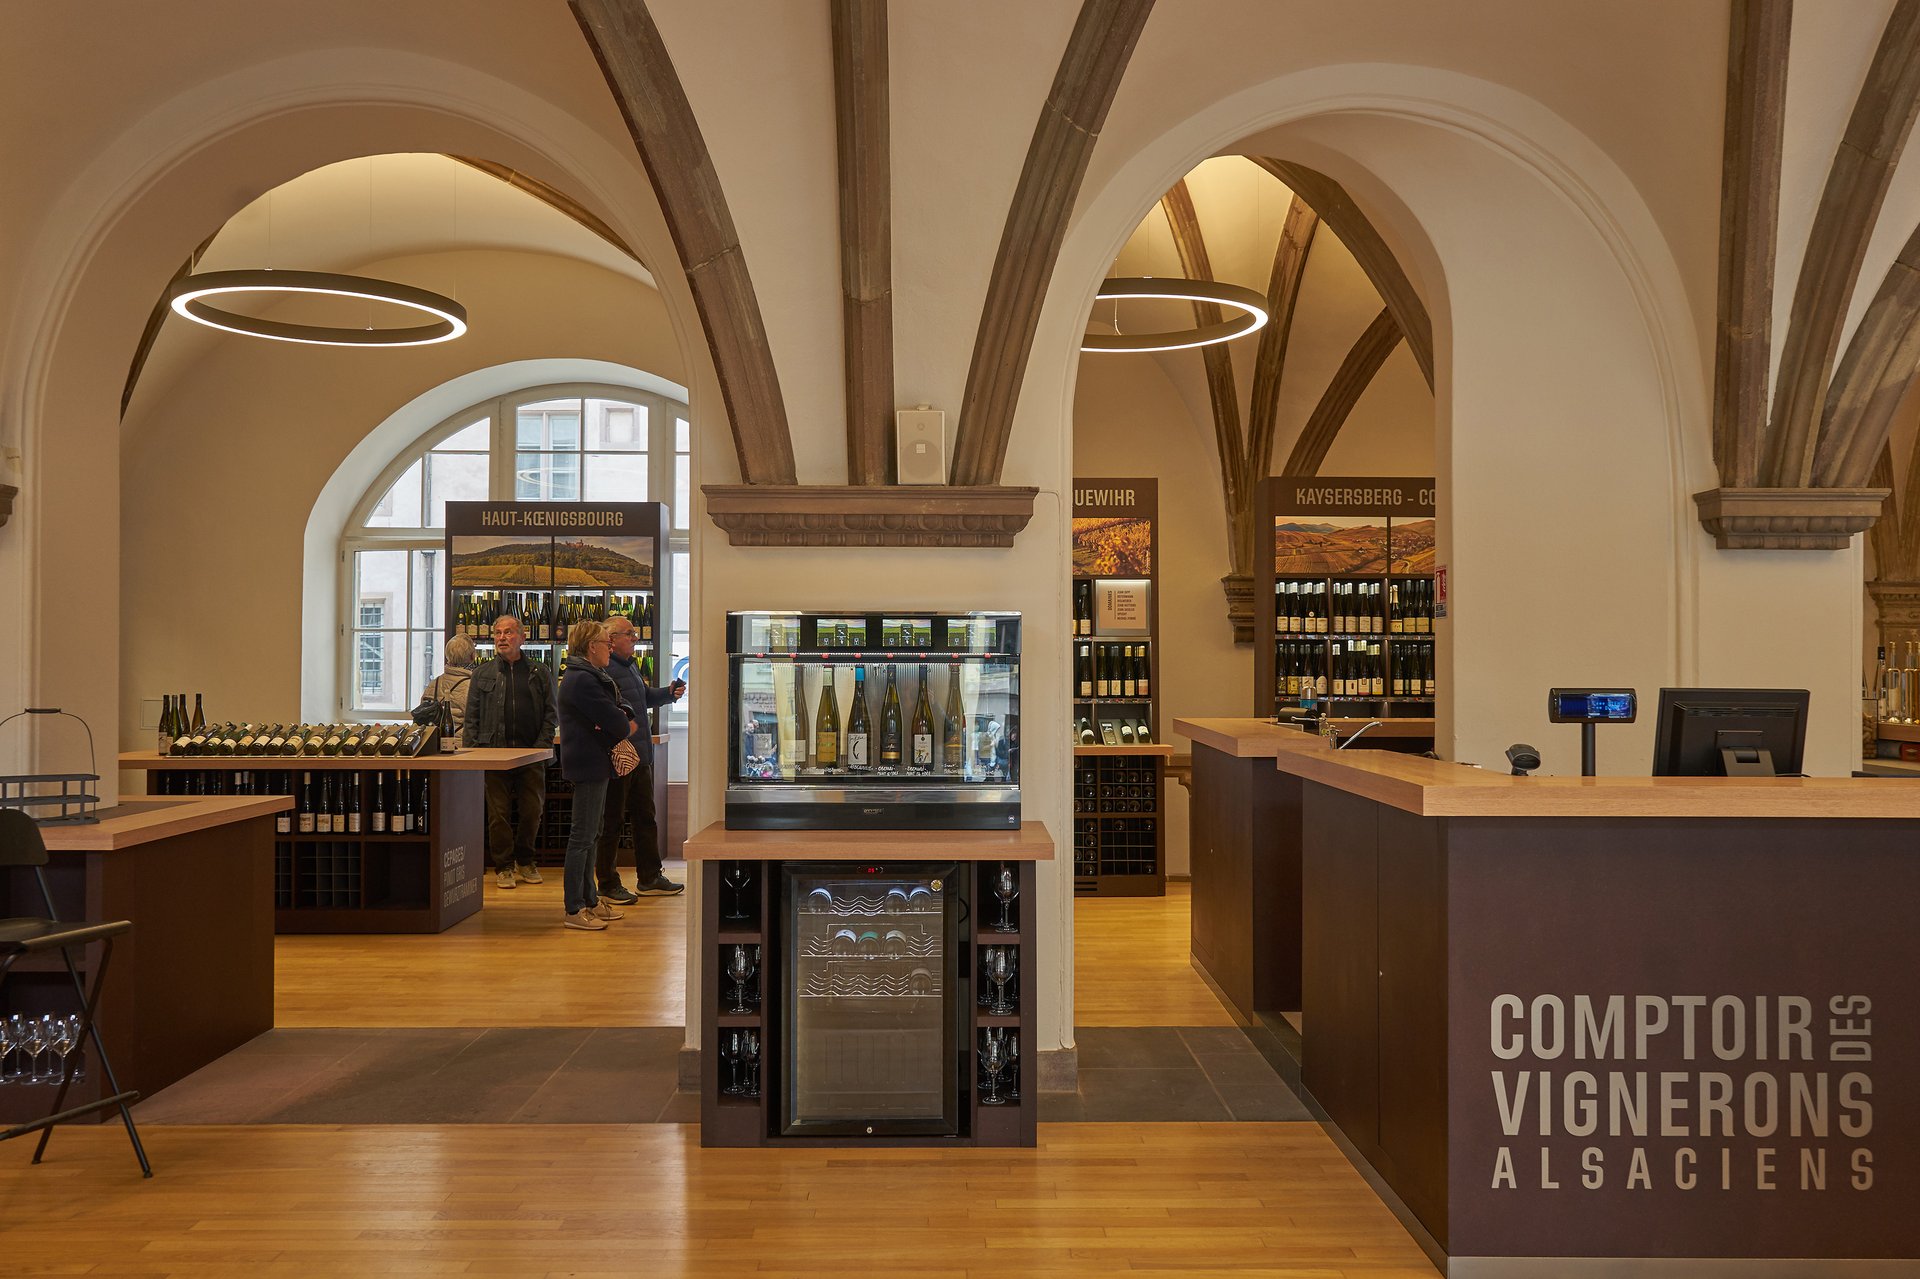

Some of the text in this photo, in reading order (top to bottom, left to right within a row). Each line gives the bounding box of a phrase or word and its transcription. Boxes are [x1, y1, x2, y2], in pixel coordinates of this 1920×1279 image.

[1072, 489, 1135, 506] UEWIHR
[1296, 488, 1402, 505] KAYSERSBERG
[482, 511, 624, 527] HAUT-KŒNIGSBOURG
[1490, 993, 1814, 1061] COMPTOIR
[1829, 994, 1872, 1061] DES
[1490, 1070, 1873, 1138] VIGNERONS
[1490, 1146, 1874, 1190] ALSACIENS
